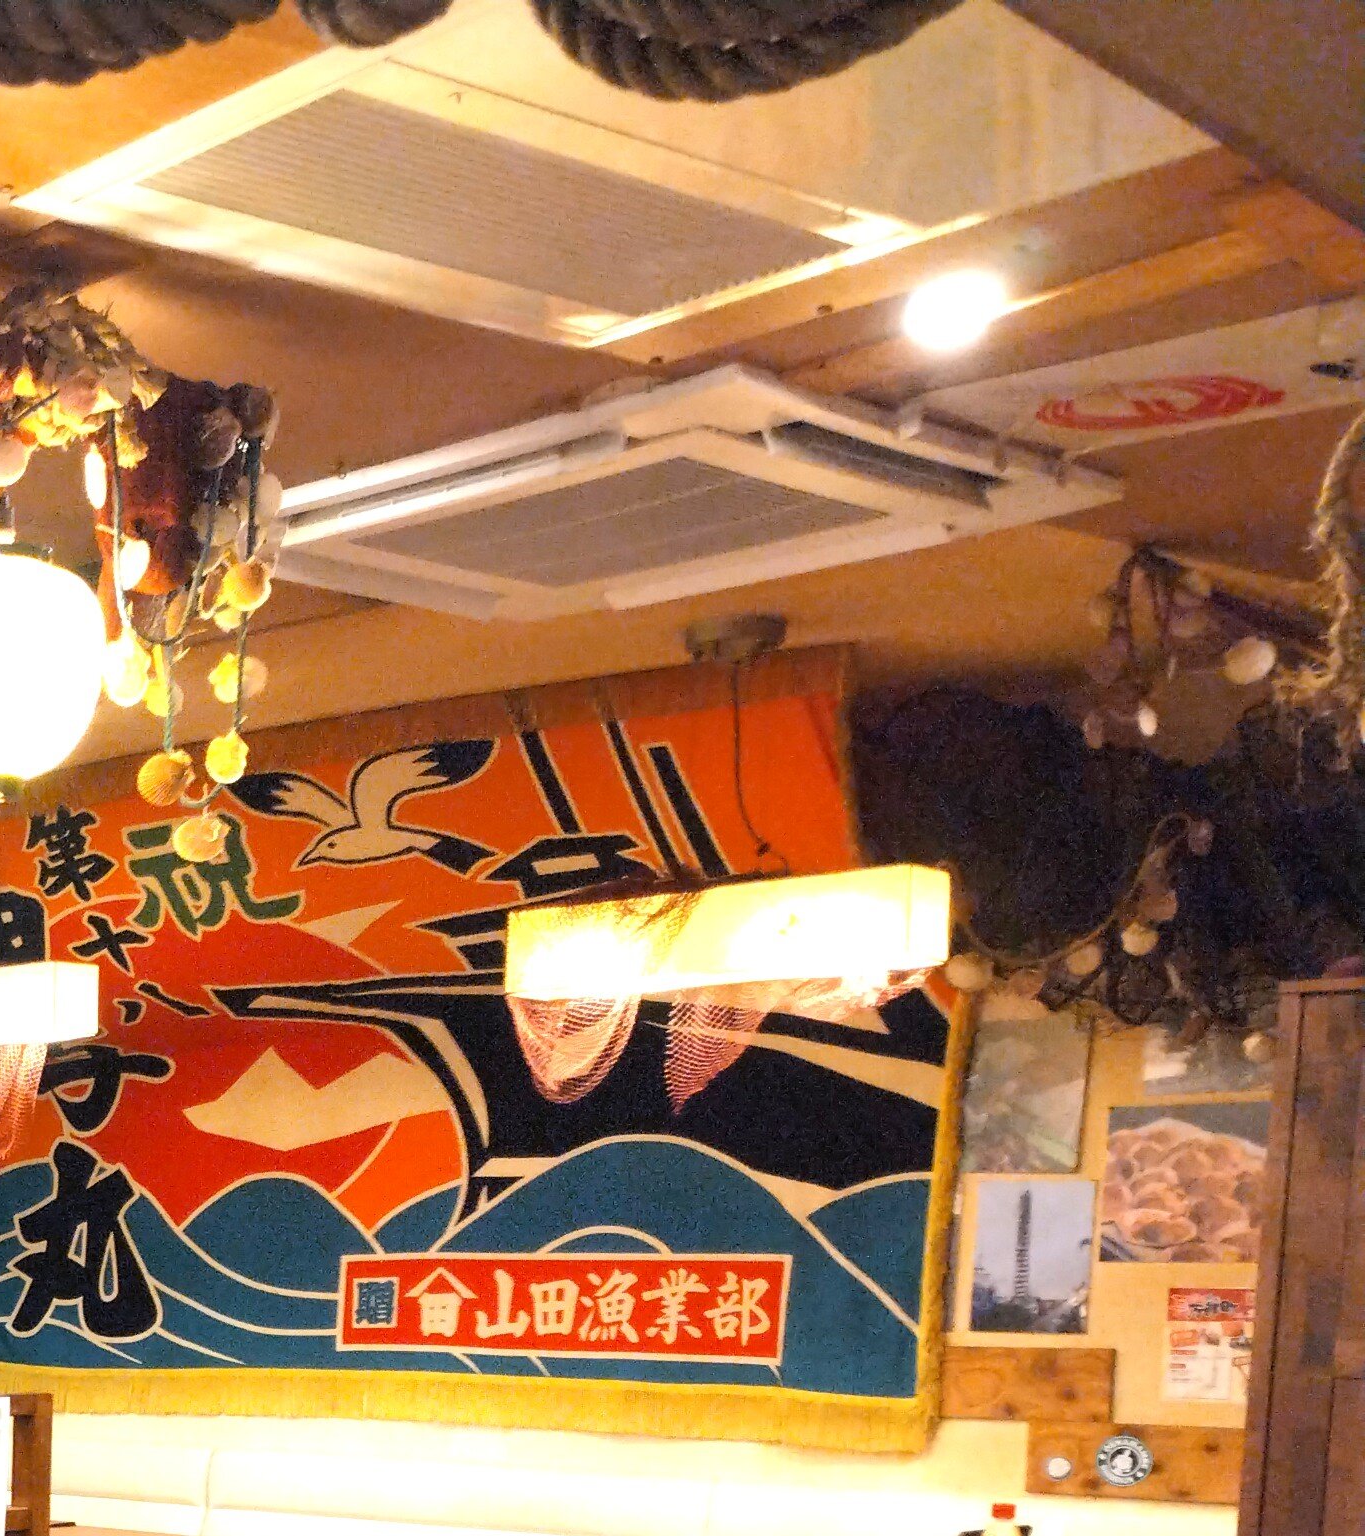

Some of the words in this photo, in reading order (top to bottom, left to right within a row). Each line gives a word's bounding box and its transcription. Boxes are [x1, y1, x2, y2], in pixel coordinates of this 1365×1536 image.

[29, 806, 211, 1022] 第十八
[127, 815, 303, 932] 祝
[475, 1268, 771, 1347] 山田漁業部
